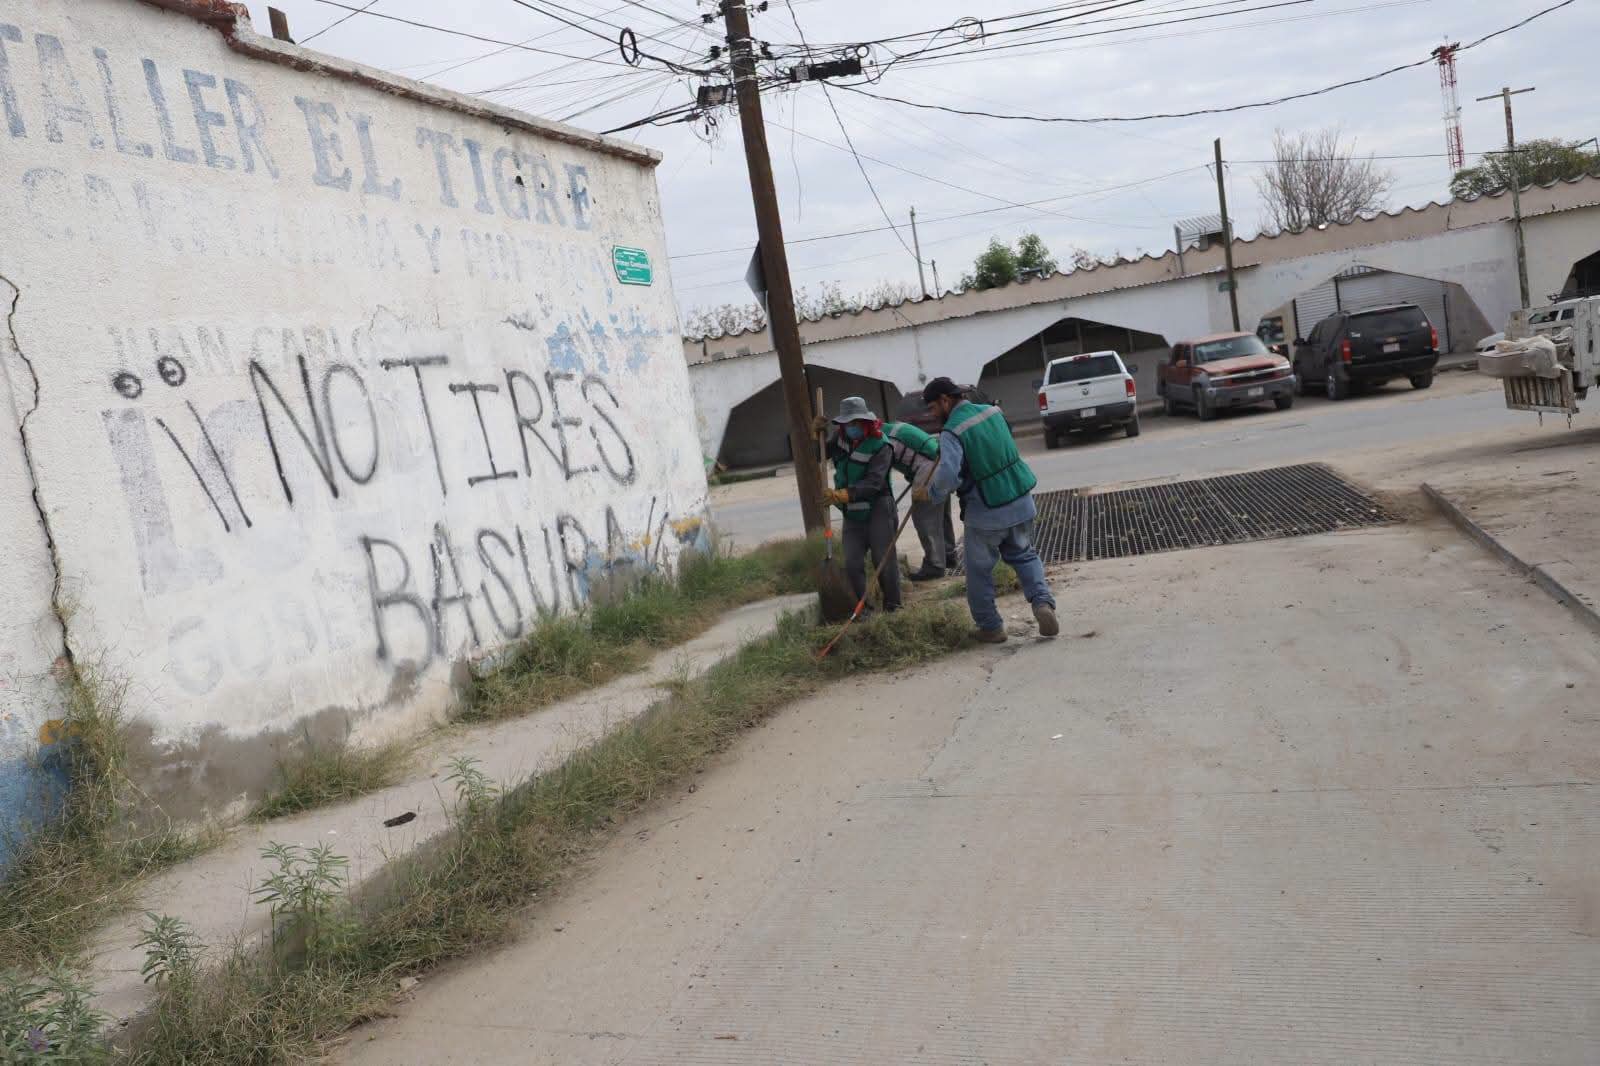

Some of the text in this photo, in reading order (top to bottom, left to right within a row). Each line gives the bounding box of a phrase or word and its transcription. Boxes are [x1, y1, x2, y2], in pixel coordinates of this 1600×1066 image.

[0, 23, 280, 179] TALLER
[294, 96, 401, 201] EL
[416, 126, 593, 231] TIGRE
[379, 353, 637, 498] TIRES
